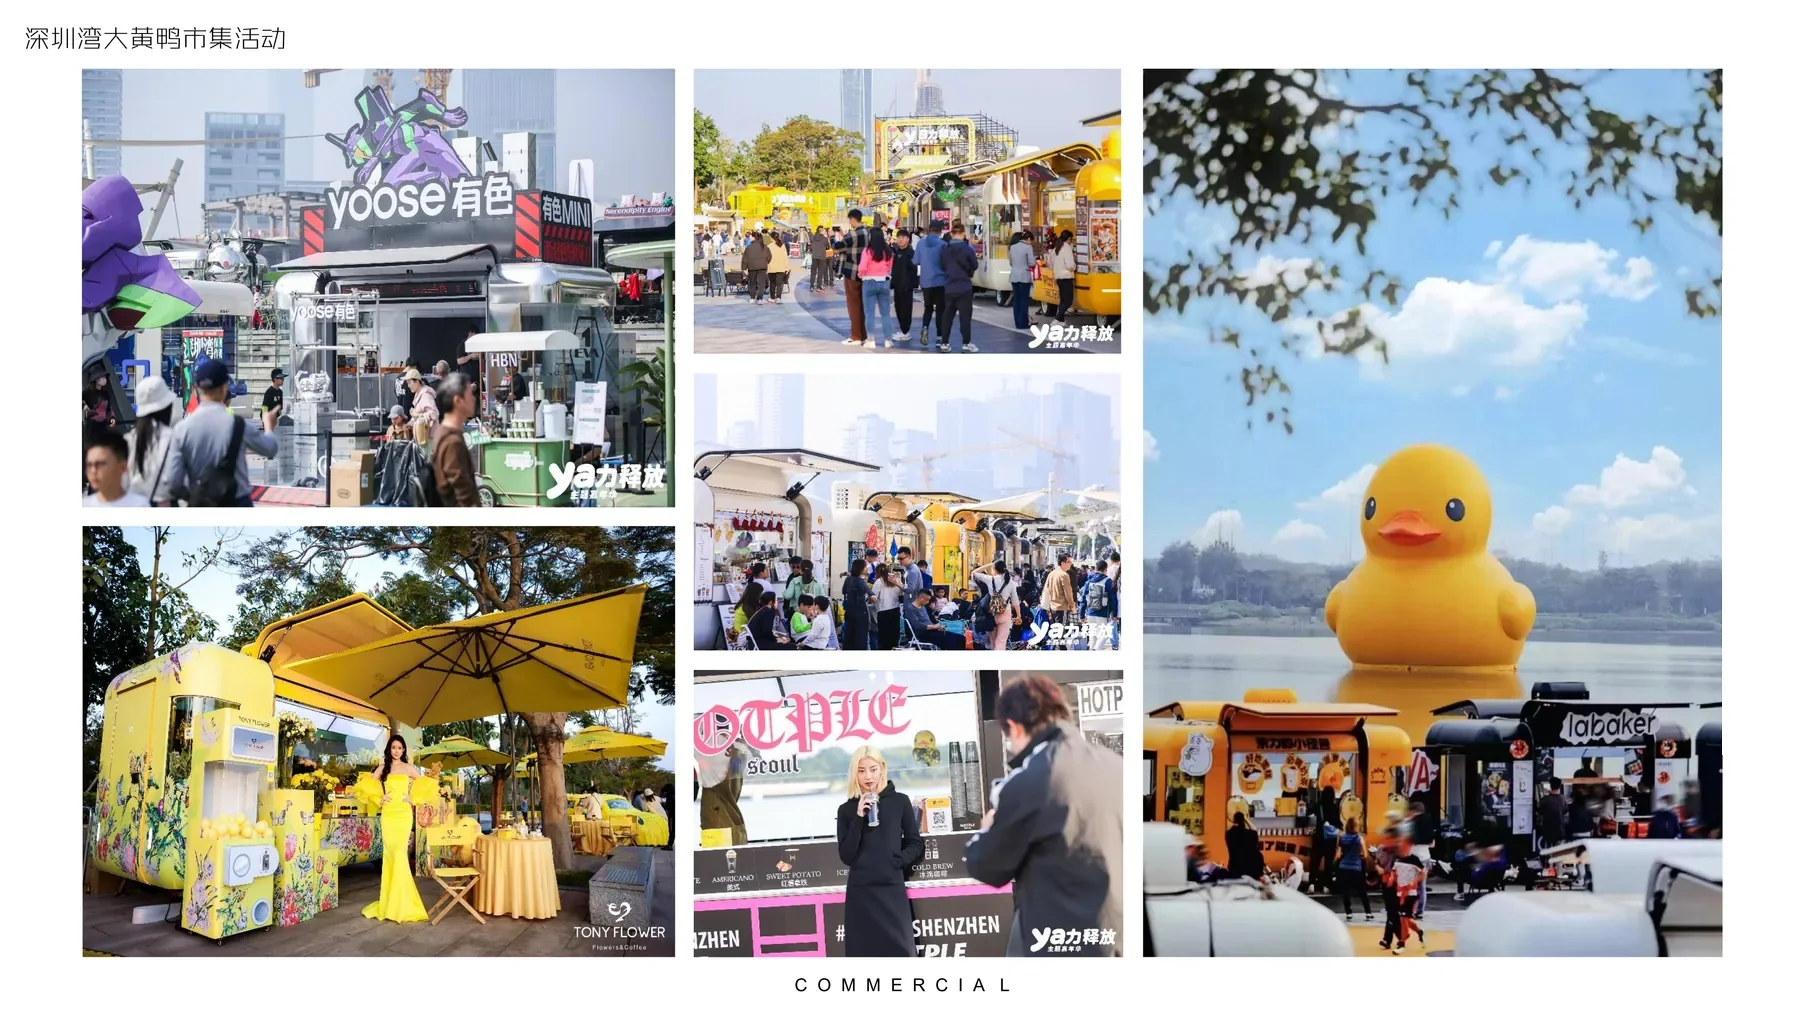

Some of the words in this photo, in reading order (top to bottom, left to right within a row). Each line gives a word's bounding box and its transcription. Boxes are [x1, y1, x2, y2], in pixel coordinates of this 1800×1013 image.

[328, 182, 446, 229] yoose
[452, 176, 514, 218] 有色
[542, 195, 591, 228] 有色MINI
[605, 206, 646, 215] Serendipity
[290, 304, 334, 321] yoose
[334, 303, 356, 320] 有色
[491, 352, 518, 367] HBN
[1080, 685, 1123, 713] HOTP
[1568, 711, 1656, 738] labaker
[747, 754, 801, 776] seoul
[766, 872, 791, 881] SWEET
[792, 870, 822, 879] POTATO
[932, 862, 954, 870] BREW
[711, 874, 755, 884] AMERICANO
[911, 915, 1000, 938] SHENZHEN
